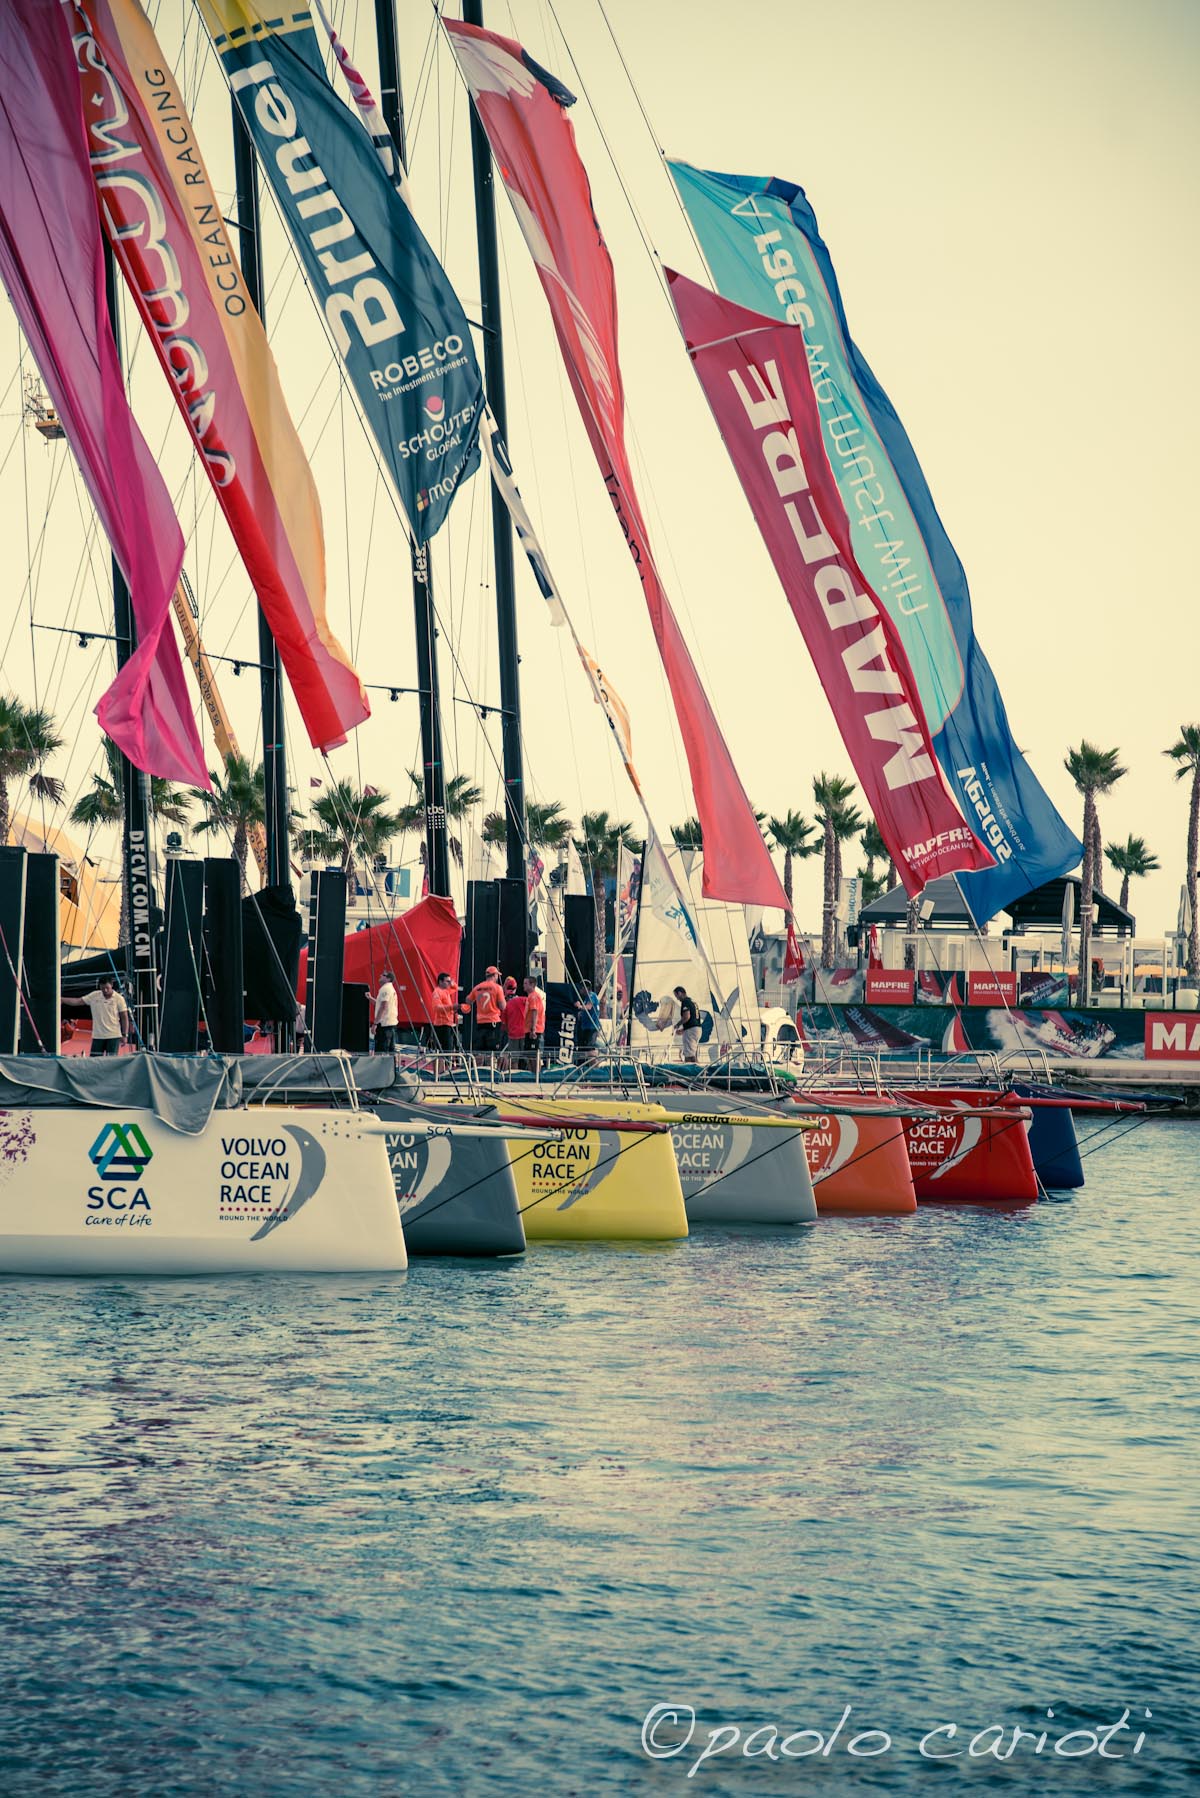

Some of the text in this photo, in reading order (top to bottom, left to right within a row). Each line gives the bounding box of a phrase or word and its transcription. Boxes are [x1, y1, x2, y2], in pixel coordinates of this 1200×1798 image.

[145, 68, 246, 317] OCEAN RACING
[229, 61, 406, 360] Brunel
[369, 335, 463, 390] ROBECO
[378, 391, 393, 402] The
[392, 370, 436, 396] Investment
[728, 359, 937, 790] MAPFRE
[173, 592, 193, 645] QUILER
[427, 803, 445, 815] tbs
[901, 827, 973, 863] MAPFRE
[129, 830, 151, 957] DFCV.COM.CN
[871, 981, 910, 989] MAPFRE
[973, 983, 1013, 991] MAPFRE
[846, 1007, 880, 1038] MAPFRE
[556, 1012, 576, 1065] estas
[683, 1114, 730, 1124] Gaastra
[427, 1126, 453, 1136] SCA
[803, 1132, 832, 1147] EAN
[909, 1125, 957, 1138] OCEAN
[221, 1138, 286, 1157] VOLVO
[672, 1133, 724, 1150] OCEAN
[909, 1141, 945, 1154] RACE
[533, 1144, 590, 1160] OCEAN
[220, 1161, 289, 1180] OCEAN
[532, 1163, 575, 1179] RACE
[86, 1186, 152, 1210] SCA
[220, 1185, 272, 1203] RACE
[85, 1214, 152, 1226] Care of Life
